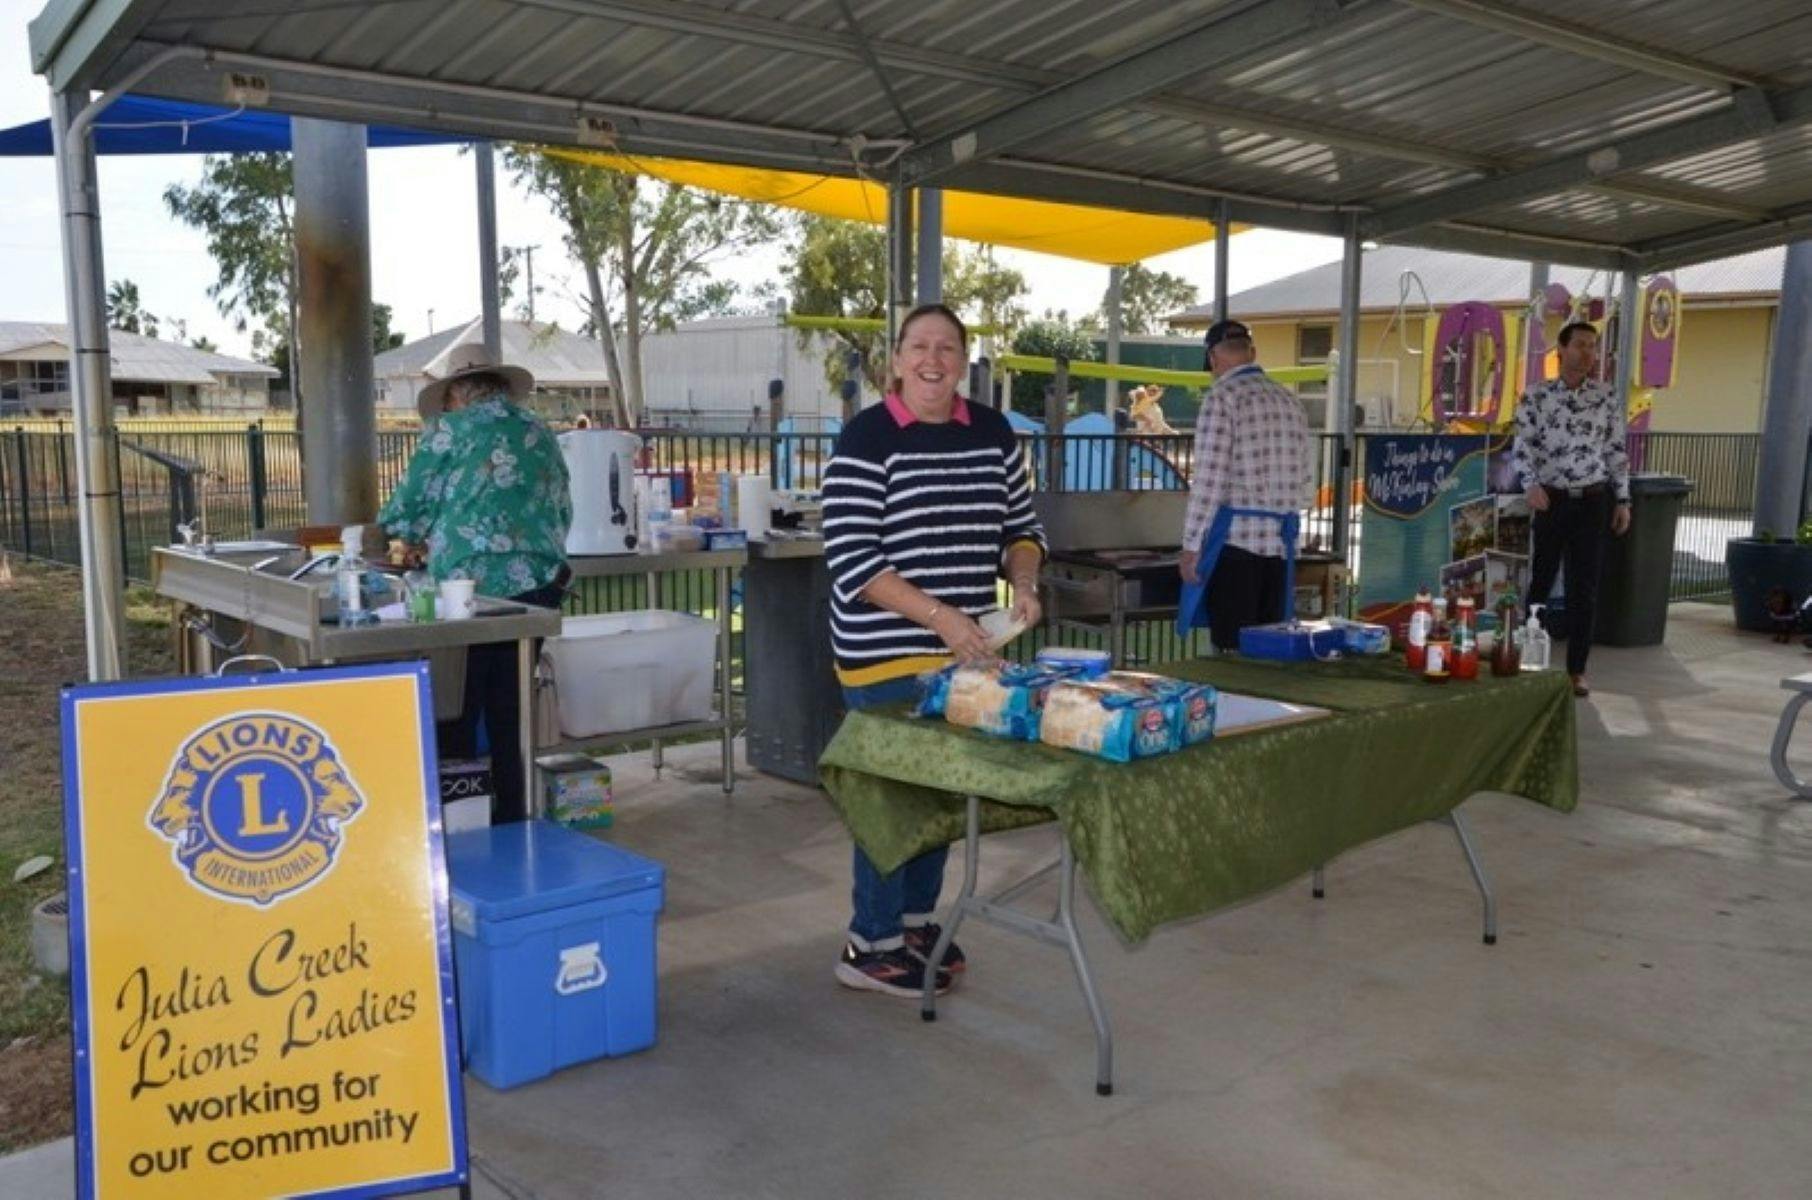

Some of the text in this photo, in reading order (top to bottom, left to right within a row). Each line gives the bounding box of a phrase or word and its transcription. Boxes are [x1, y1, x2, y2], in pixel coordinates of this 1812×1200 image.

[195, 722, 313, 764] LIONS
[235, 772, 290, 837] L
[204, 850, 320, 888] INTERNATIONAL
[116, 922, 370, 1051] Julia Creek
[130, 989, 417, 1100] Lions Ladies
[167, 1071, 381, 1127] working for
[129, 1108, 419, 1178] our community
